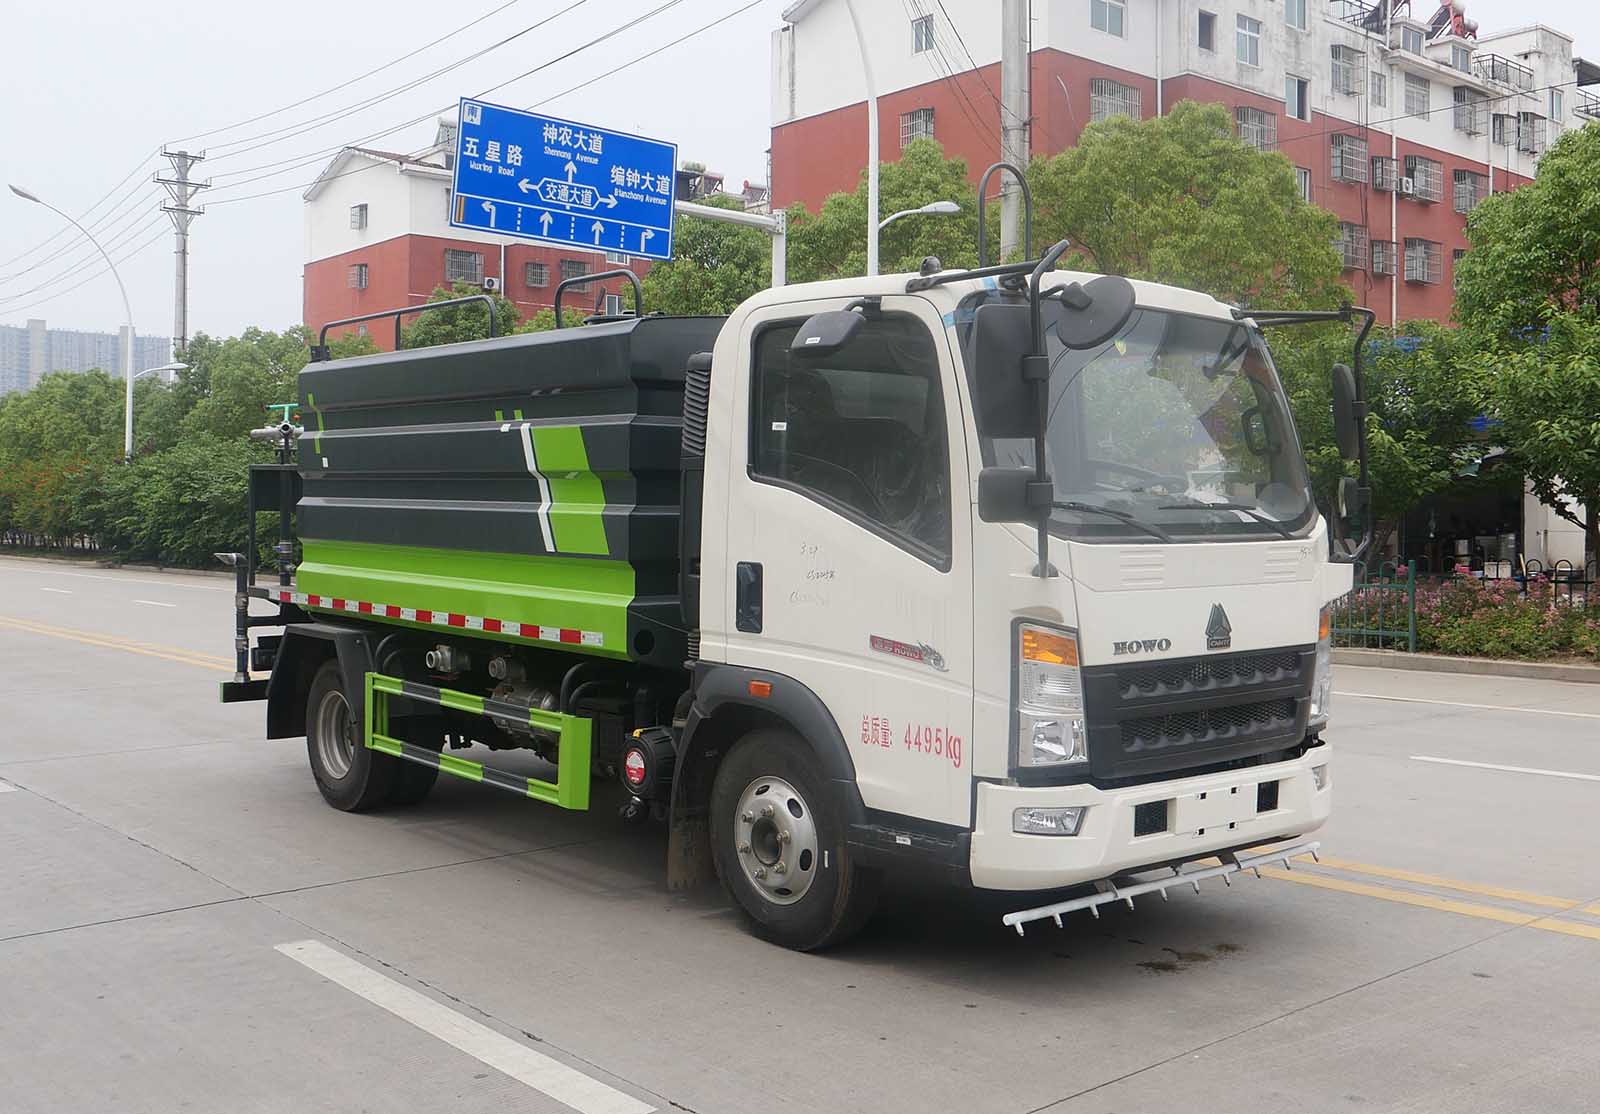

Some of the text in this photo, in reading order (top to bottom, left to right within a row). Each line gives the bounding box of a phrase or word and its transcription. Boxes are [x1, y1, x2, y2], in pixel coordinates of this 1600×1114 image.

[463, 136, 523, 166] 五星路
[543, 123, 603, 155] 神农大道
[469, 160, 515, 177] Wuxing Road
[575, 152, 599, 165] Avenue
[610, 165, 671, 195] 编钟大道
[546, 182, 593, 207] 交通大道
[645, 194, 667, 206] Avenue
[1112, 638, 1172, 655] HOWO
[904, 722, 962, 769] 4495kg
